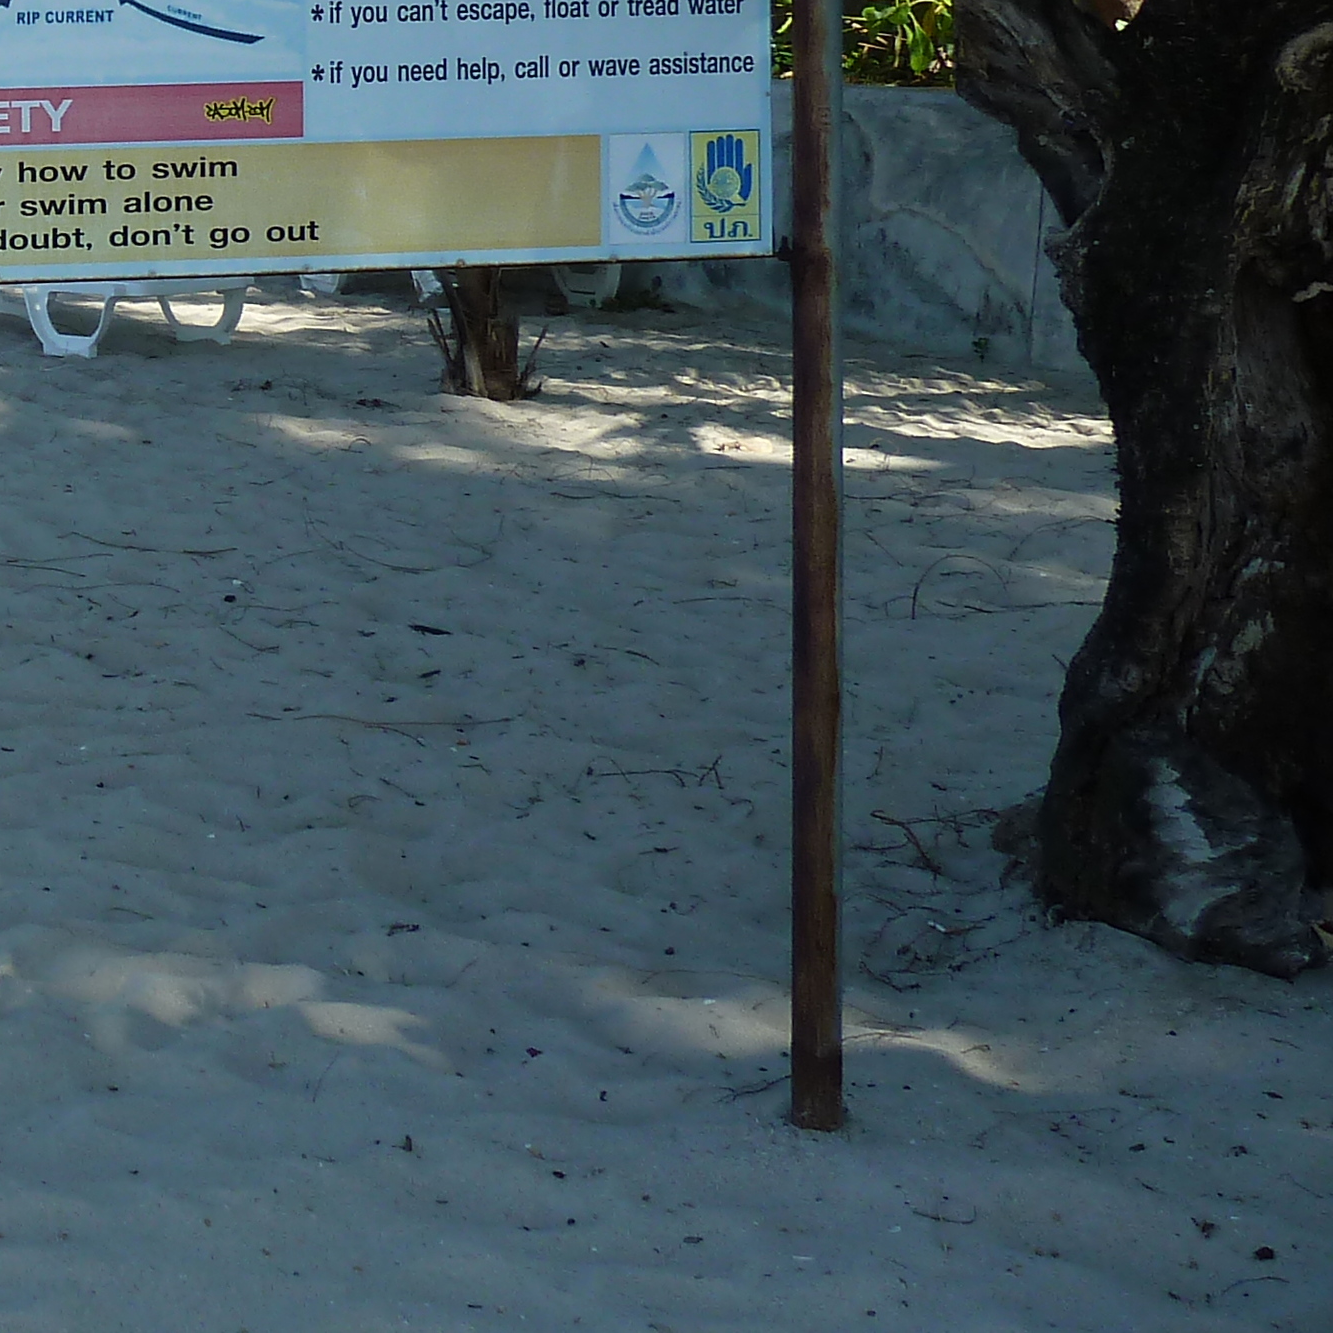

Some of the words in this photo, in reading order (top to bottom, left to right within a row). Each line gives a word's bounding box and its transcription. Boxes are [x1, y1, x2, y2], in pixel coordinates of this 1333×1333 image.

[17, 12, 39, 25] RIP
[46, 10, 114, 23] CURRENT
[330, 1, 342, 23] if
[351, 6, 387, 28] you
[457, 3, 534, 24] escape,
[599, 1, 619, 17] or
[330, 61, 343, 83] if
[351, 66, 387, 88] you
[398, 58, 447, 81] need
[457, 57, 505, 84] help,
[515, 56, 548, 78] call
[559, 61, 580, 77] or
[588, 59, 640, 76] wave
[650, 52, 754, 75] assistance
[19, 162, 88, 182] how
[103, 161, 135, 180] to
[152, 157, 237, 178] swim
[21, 194, 106, 216] swim
[124, 192, 213, 213] alone
[110, 224, 194, 246] don't
[210, 228, 249, 248] go
[267, 221, 319, 241] out
